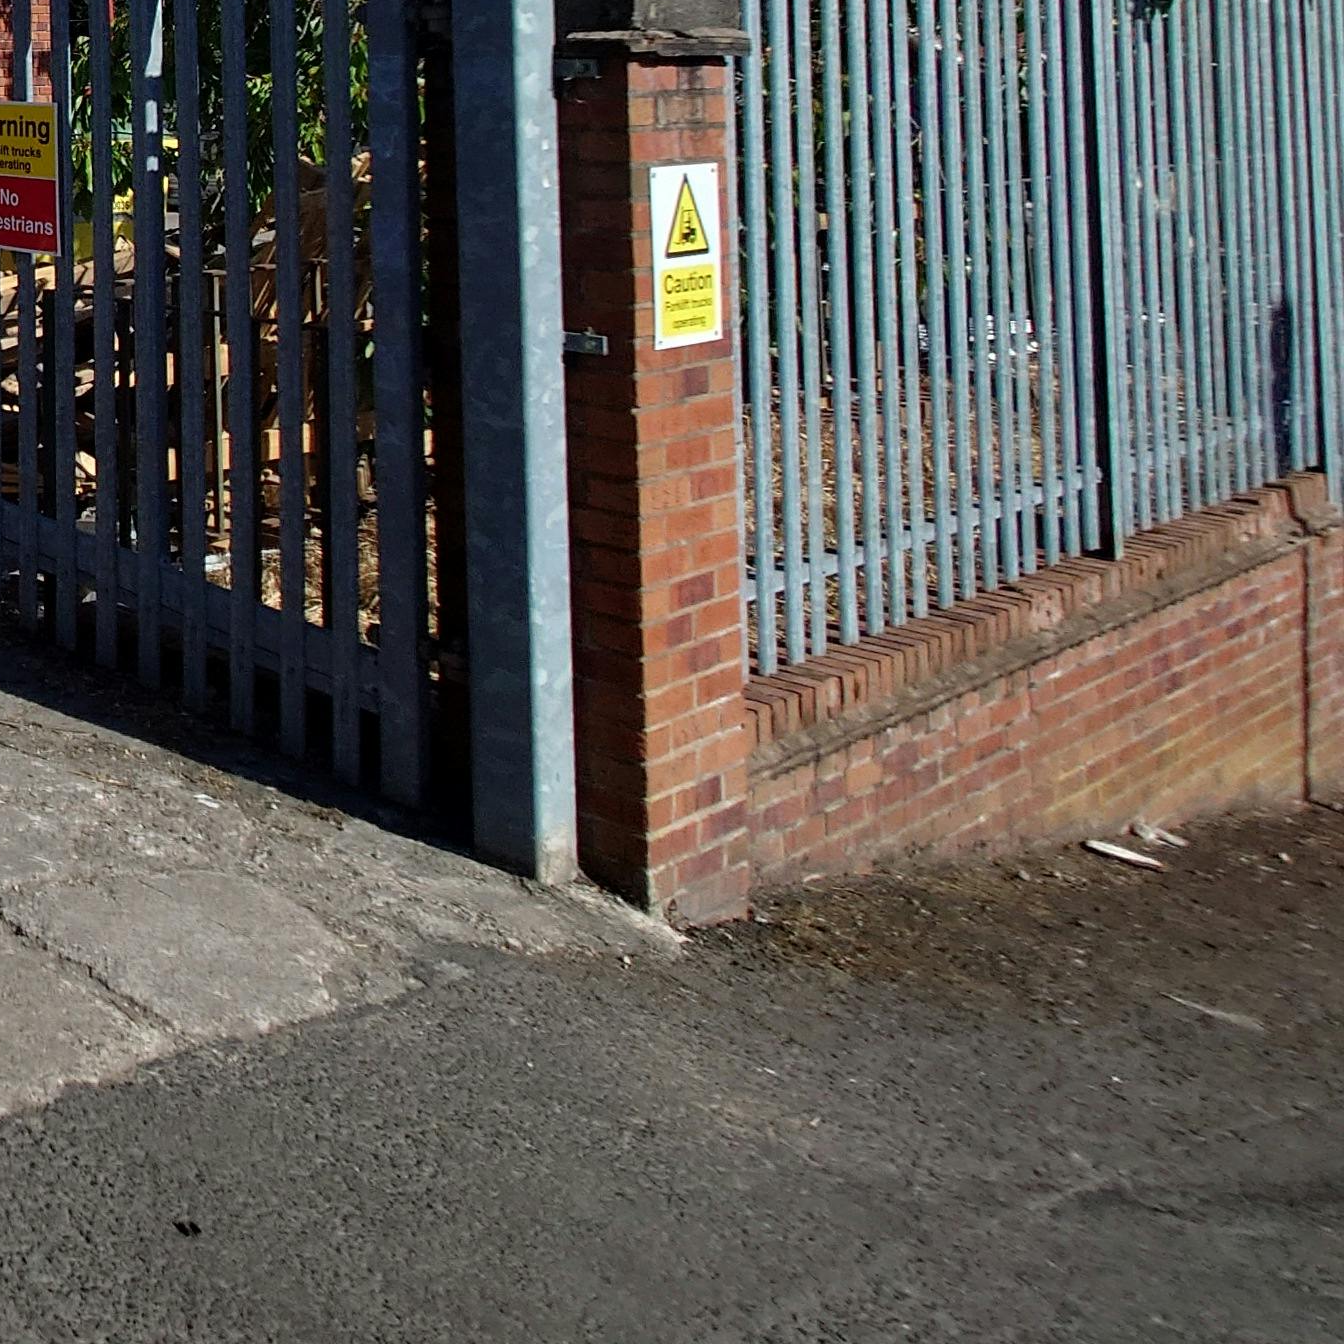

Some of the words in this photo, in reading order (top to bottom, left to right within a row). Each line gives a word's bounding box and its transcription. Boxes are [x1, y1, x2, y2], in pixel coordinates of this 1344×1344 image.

[10, 146, 42, 159] trucks
[0, 188, 20, 206] No
[664, 271, 713, 294] Caution
